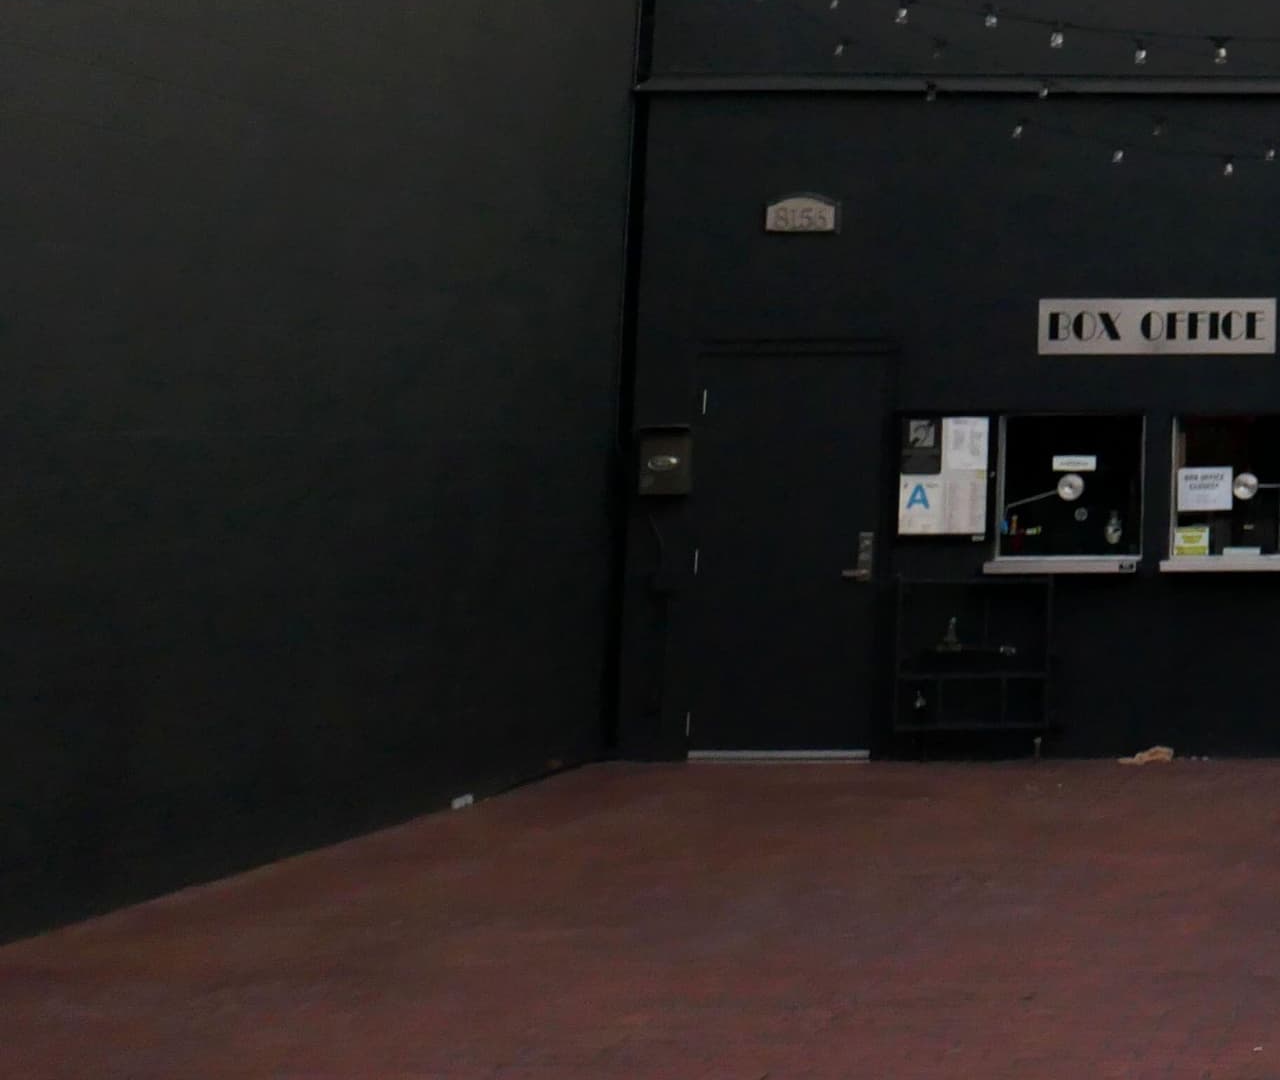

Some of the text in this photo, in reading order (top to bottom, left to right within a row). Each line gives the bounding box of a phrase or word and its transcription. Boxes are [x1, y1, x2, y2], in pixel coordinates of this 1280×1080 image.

[1048, 310, 1266, 341] BOX OFFICE
[906, 483, 930, 510] A
